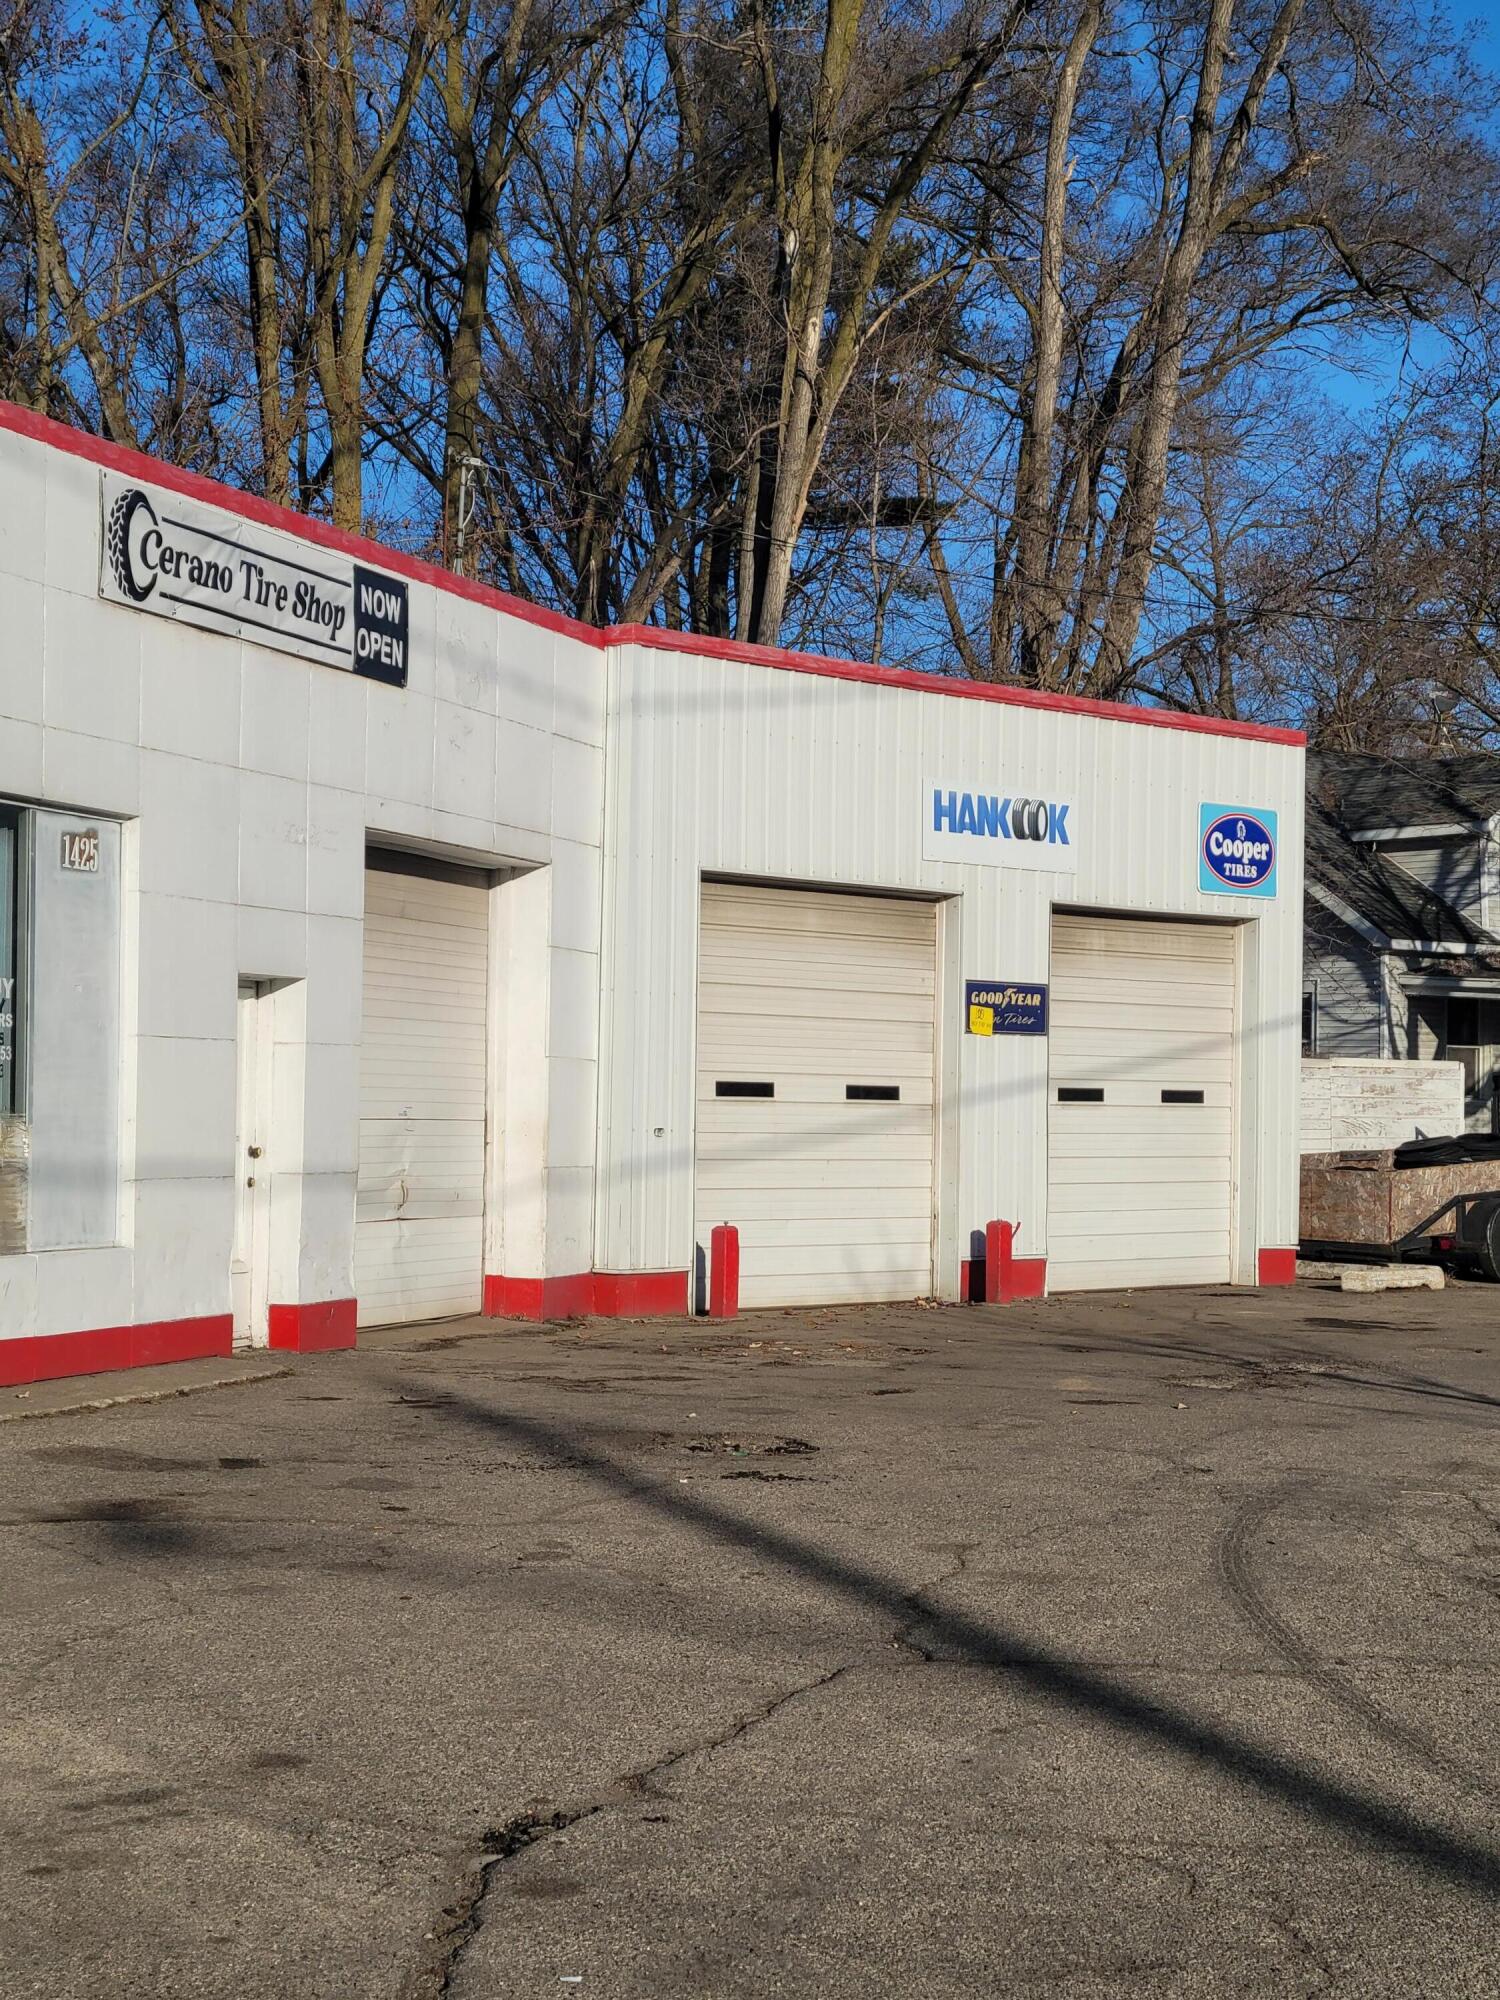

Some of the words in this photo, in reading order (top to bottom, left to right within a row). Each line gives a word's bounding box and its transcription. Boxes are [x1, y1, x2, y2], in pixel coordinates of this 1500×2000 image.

[140, 529, 233, 593] Cerano
[240, 560, 288, 612] Tire
[292, 581, 346, 641] Shop
[360, 584, 402, 625] NOW
[357, 627, 404, 669] OPEN
[933, 788, 1070, 845] HANKOOK
[62, 834, 99, 872] 1425
[1209, 831, 1270, 864] Cooper
[1223, 862, 1258, 879] TIRES
[971, 988, 1042, 1008] GOODYEAR
[1003, 1012, 1037, 1026] Tires
